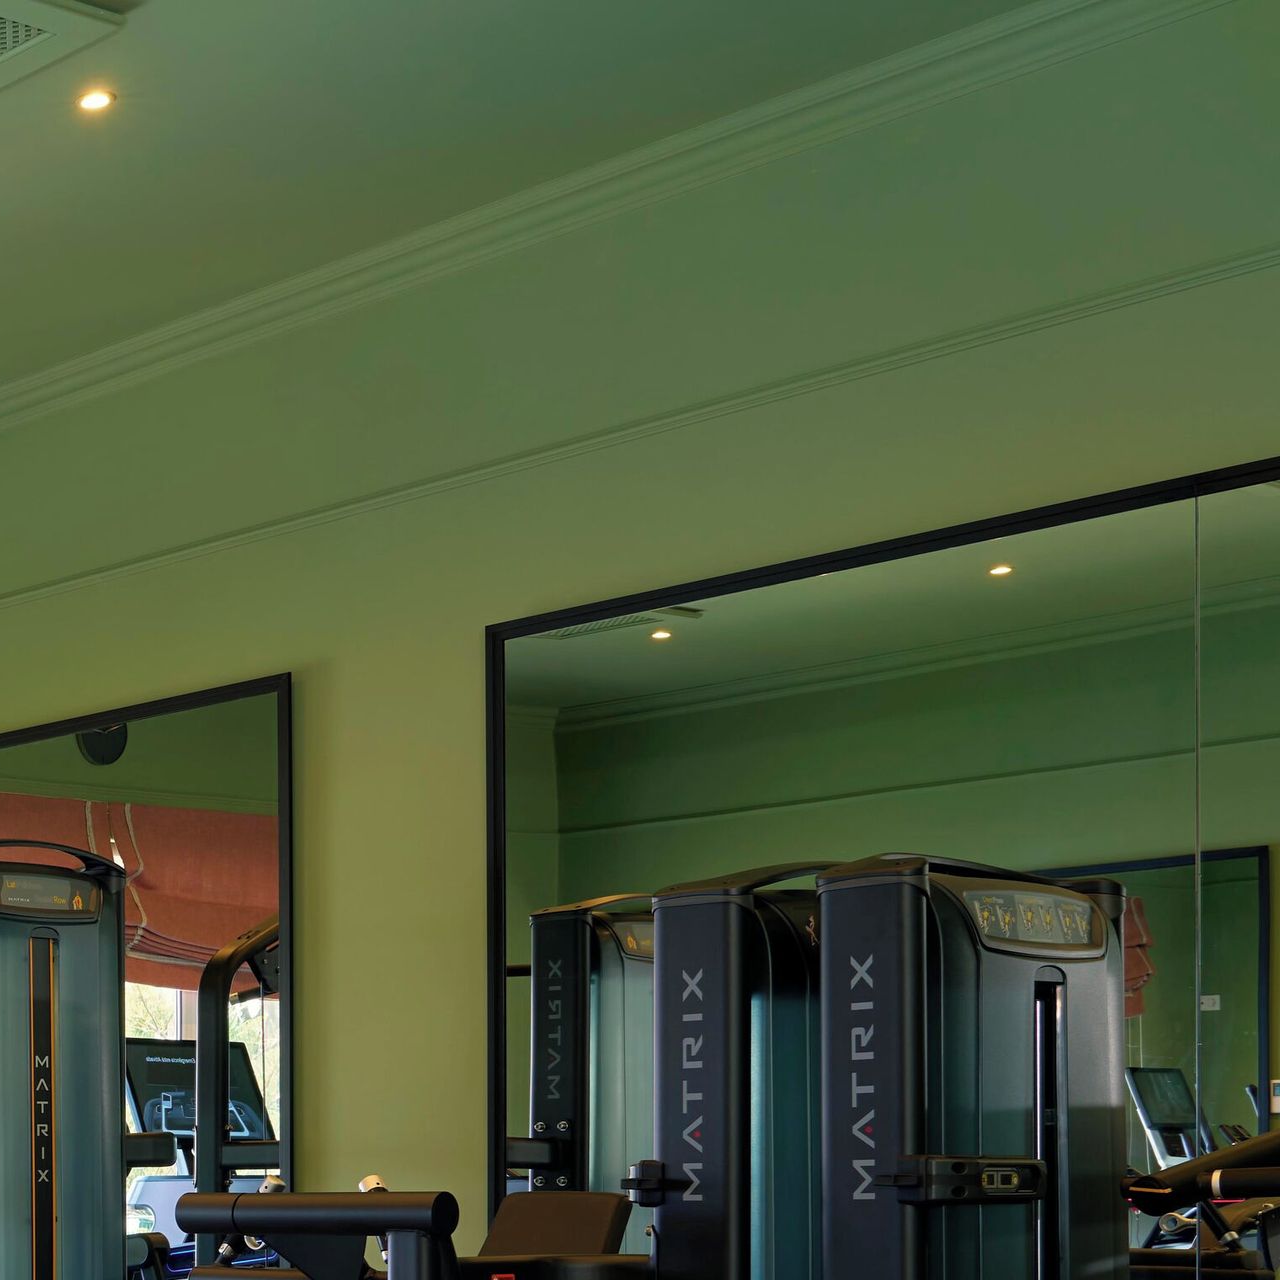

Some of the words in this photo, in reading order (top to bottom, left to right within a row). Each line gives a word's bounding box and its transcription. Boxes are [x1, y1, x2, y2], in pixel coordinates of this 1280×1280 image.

[35, 1055, 49, 1182] MATRIX
[682, 968, 703, 1201] MATRIX
[850, 954, 876, 1200] MATRIX
